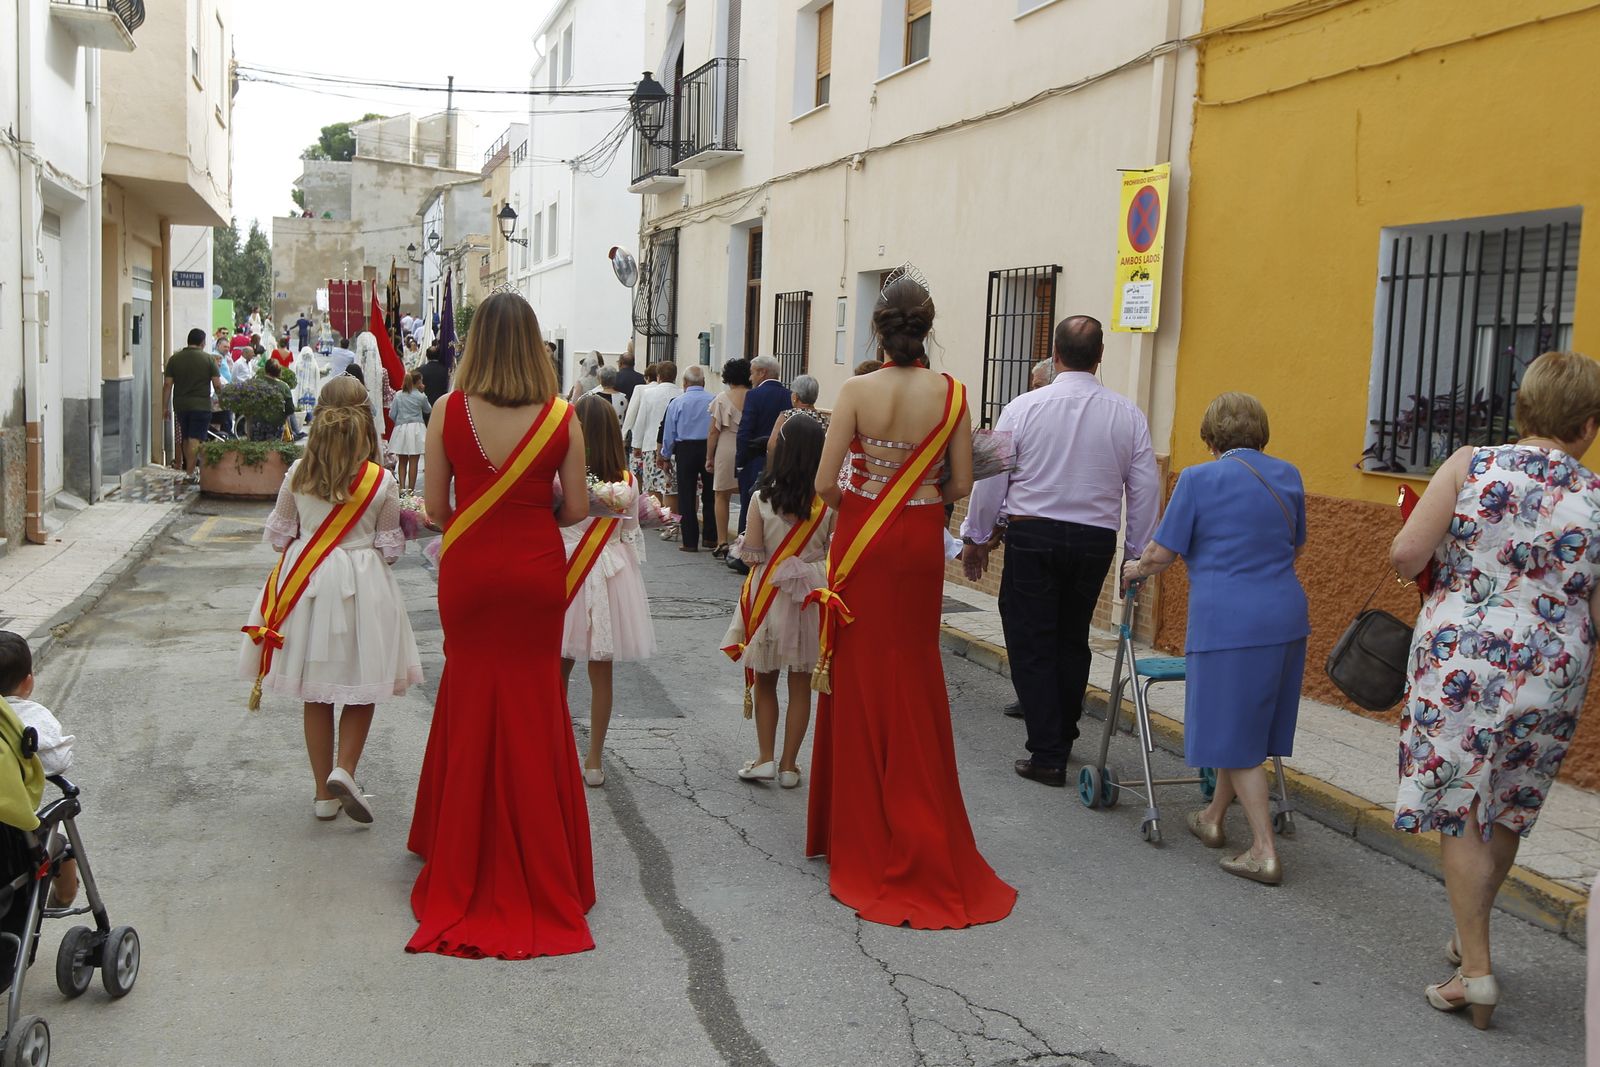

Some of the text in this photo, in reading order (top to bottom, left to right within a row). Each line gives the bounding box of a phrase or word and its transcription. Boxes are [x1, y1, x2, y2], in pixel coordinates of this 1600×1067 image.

[1123, 177, 1147, 186] PROHIBIDO
[1120, 254, 1160, 266] AMBOS LADOS
